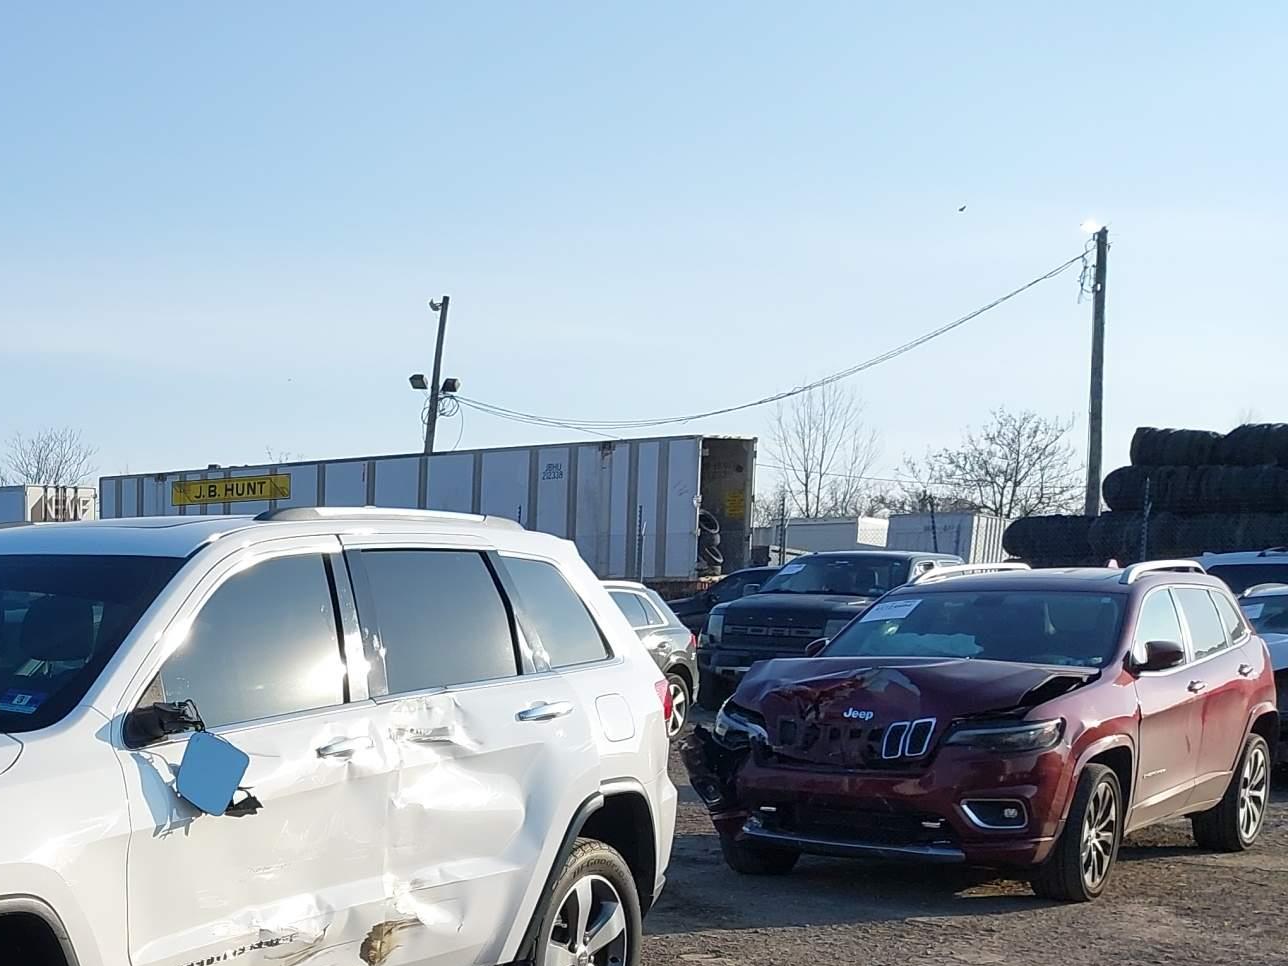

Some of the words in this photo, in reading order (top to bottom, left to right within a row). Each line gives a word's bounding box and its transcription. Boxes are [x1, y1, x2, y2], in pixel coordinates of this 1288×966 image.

[194, 485, 205, 499] J.
[208, 484, 220, 497] B.
[224, 481, 266, 496] HUNT
[726, 624, 815, 638] FORD
[843, 707, 874, 721] Jeep
